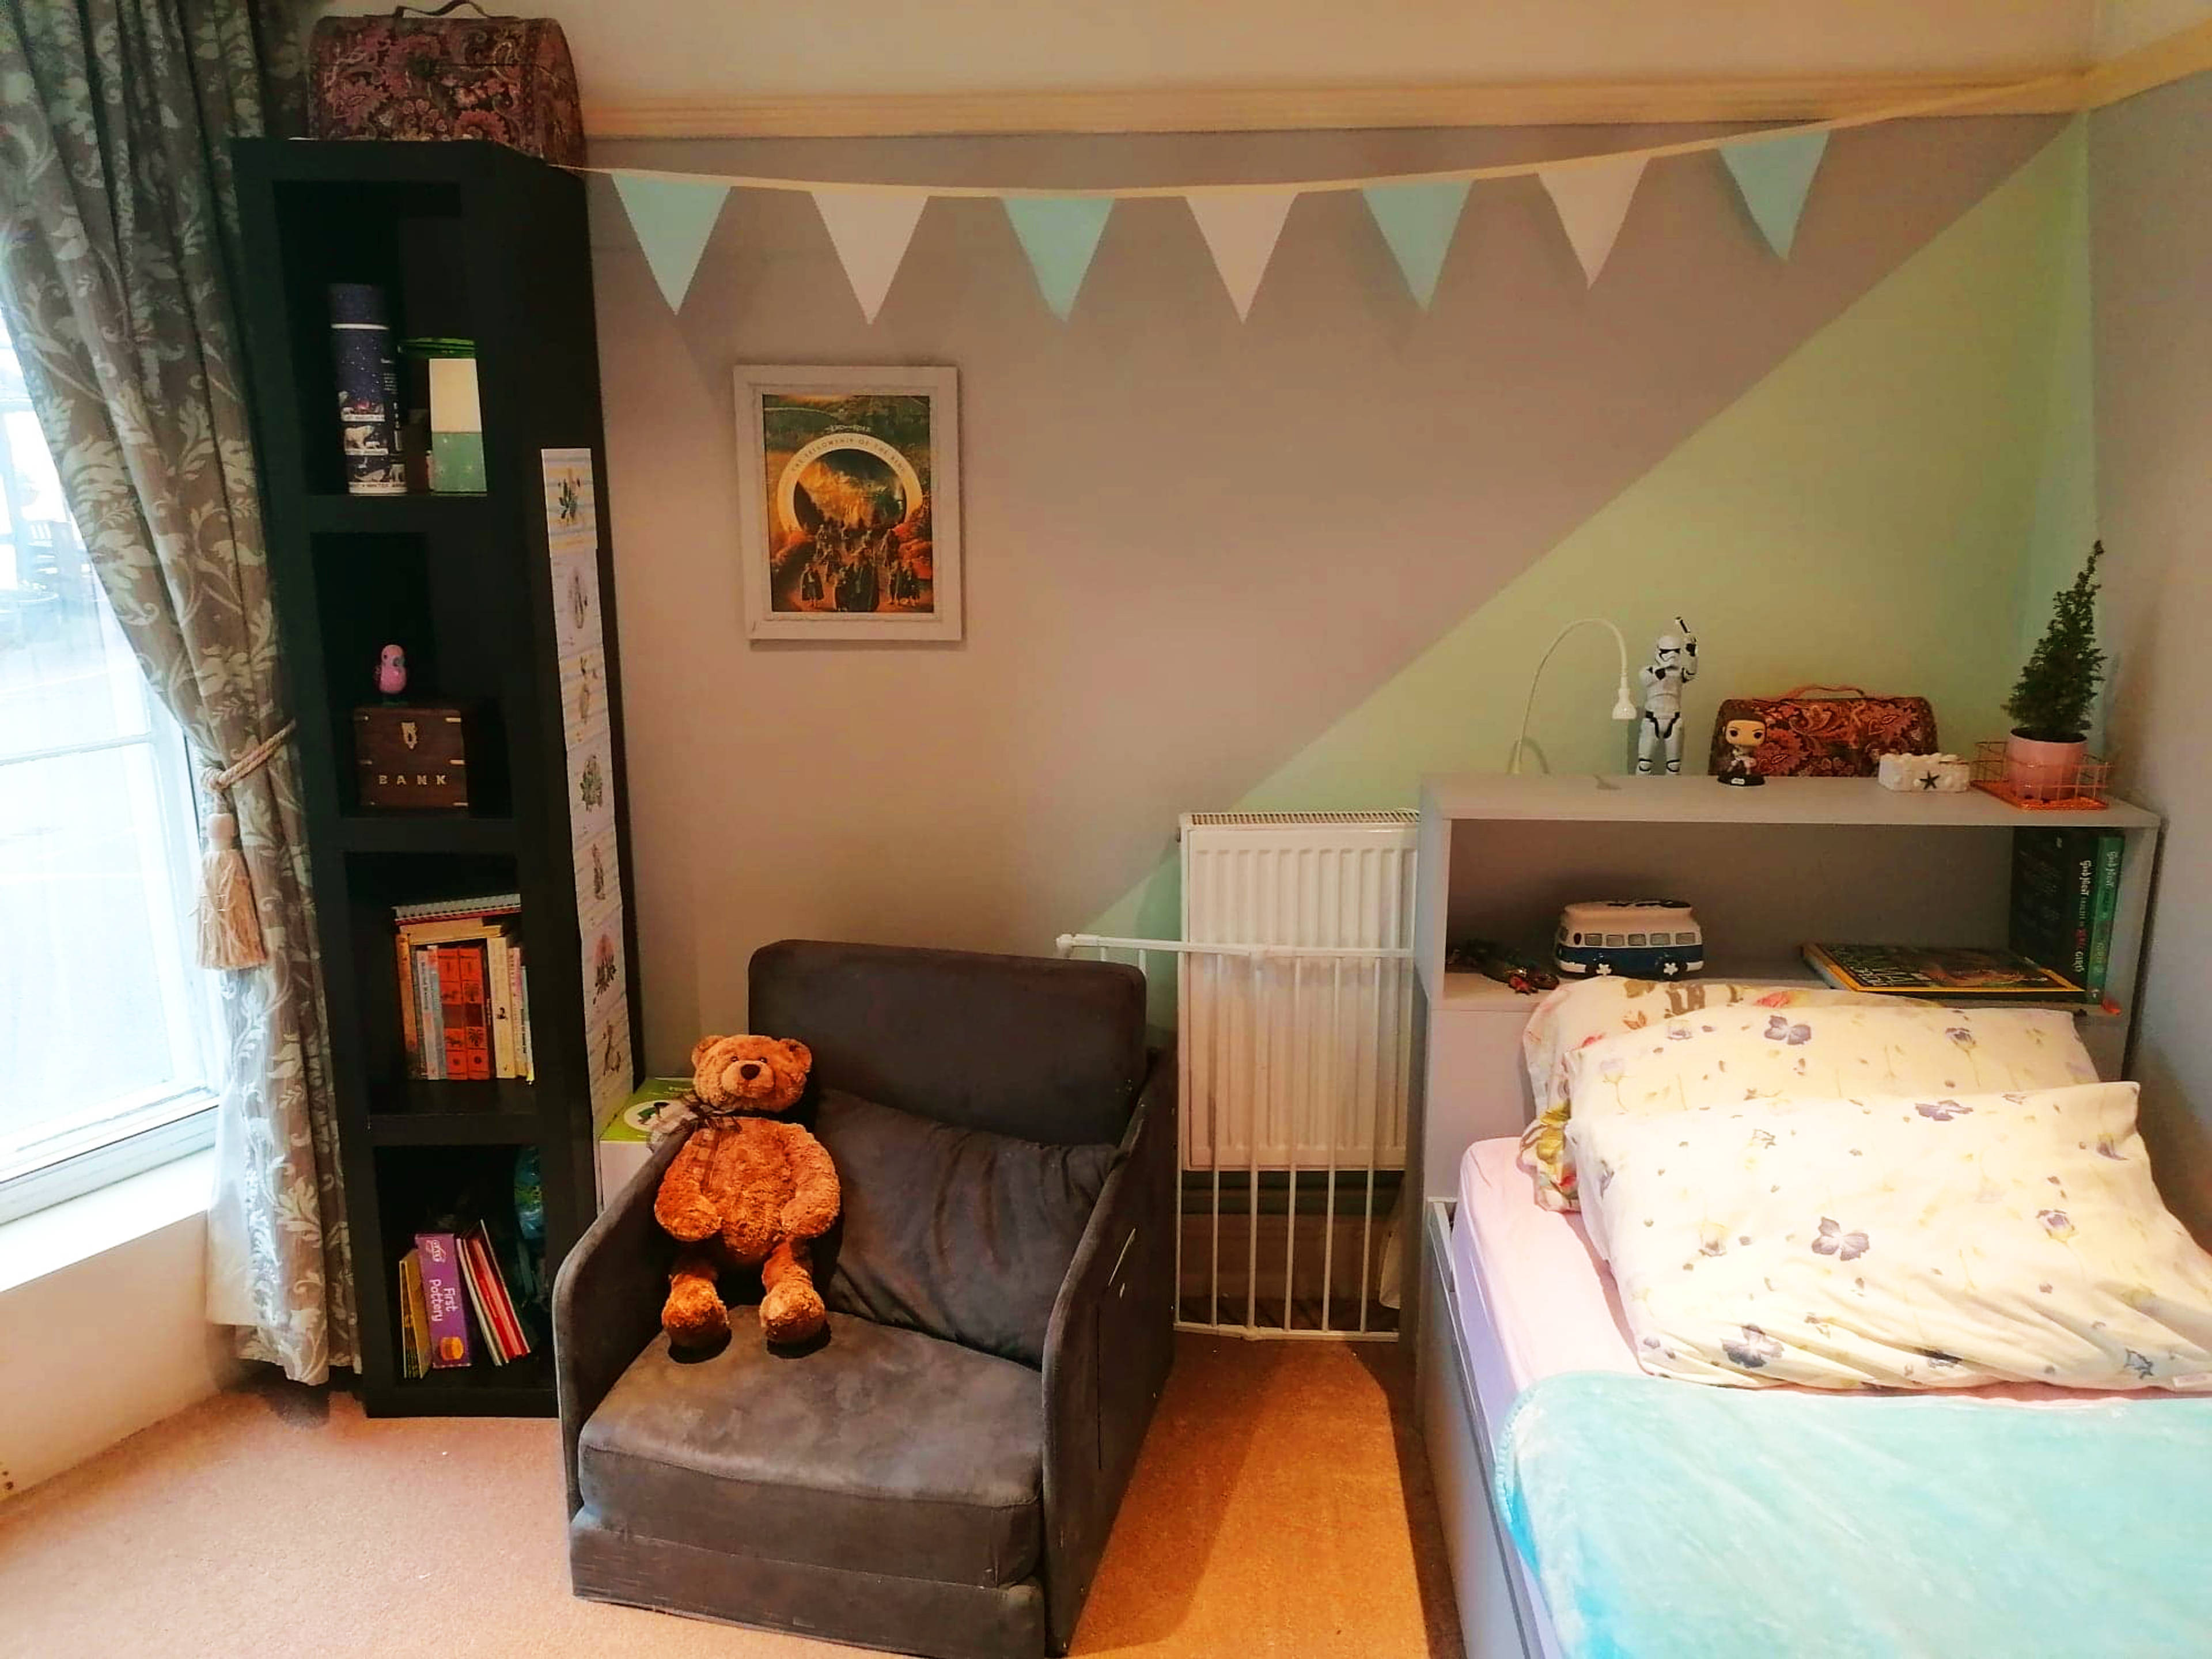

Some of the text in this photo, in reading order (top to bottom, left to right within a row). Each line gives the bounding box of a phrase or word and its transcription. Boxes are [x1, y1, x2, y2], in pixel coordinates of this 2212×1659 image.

[378, 774, 448, 786] BANK
[429, 1279, 444, 1321] Pottery
[444, 1287, 459, 1312] First
